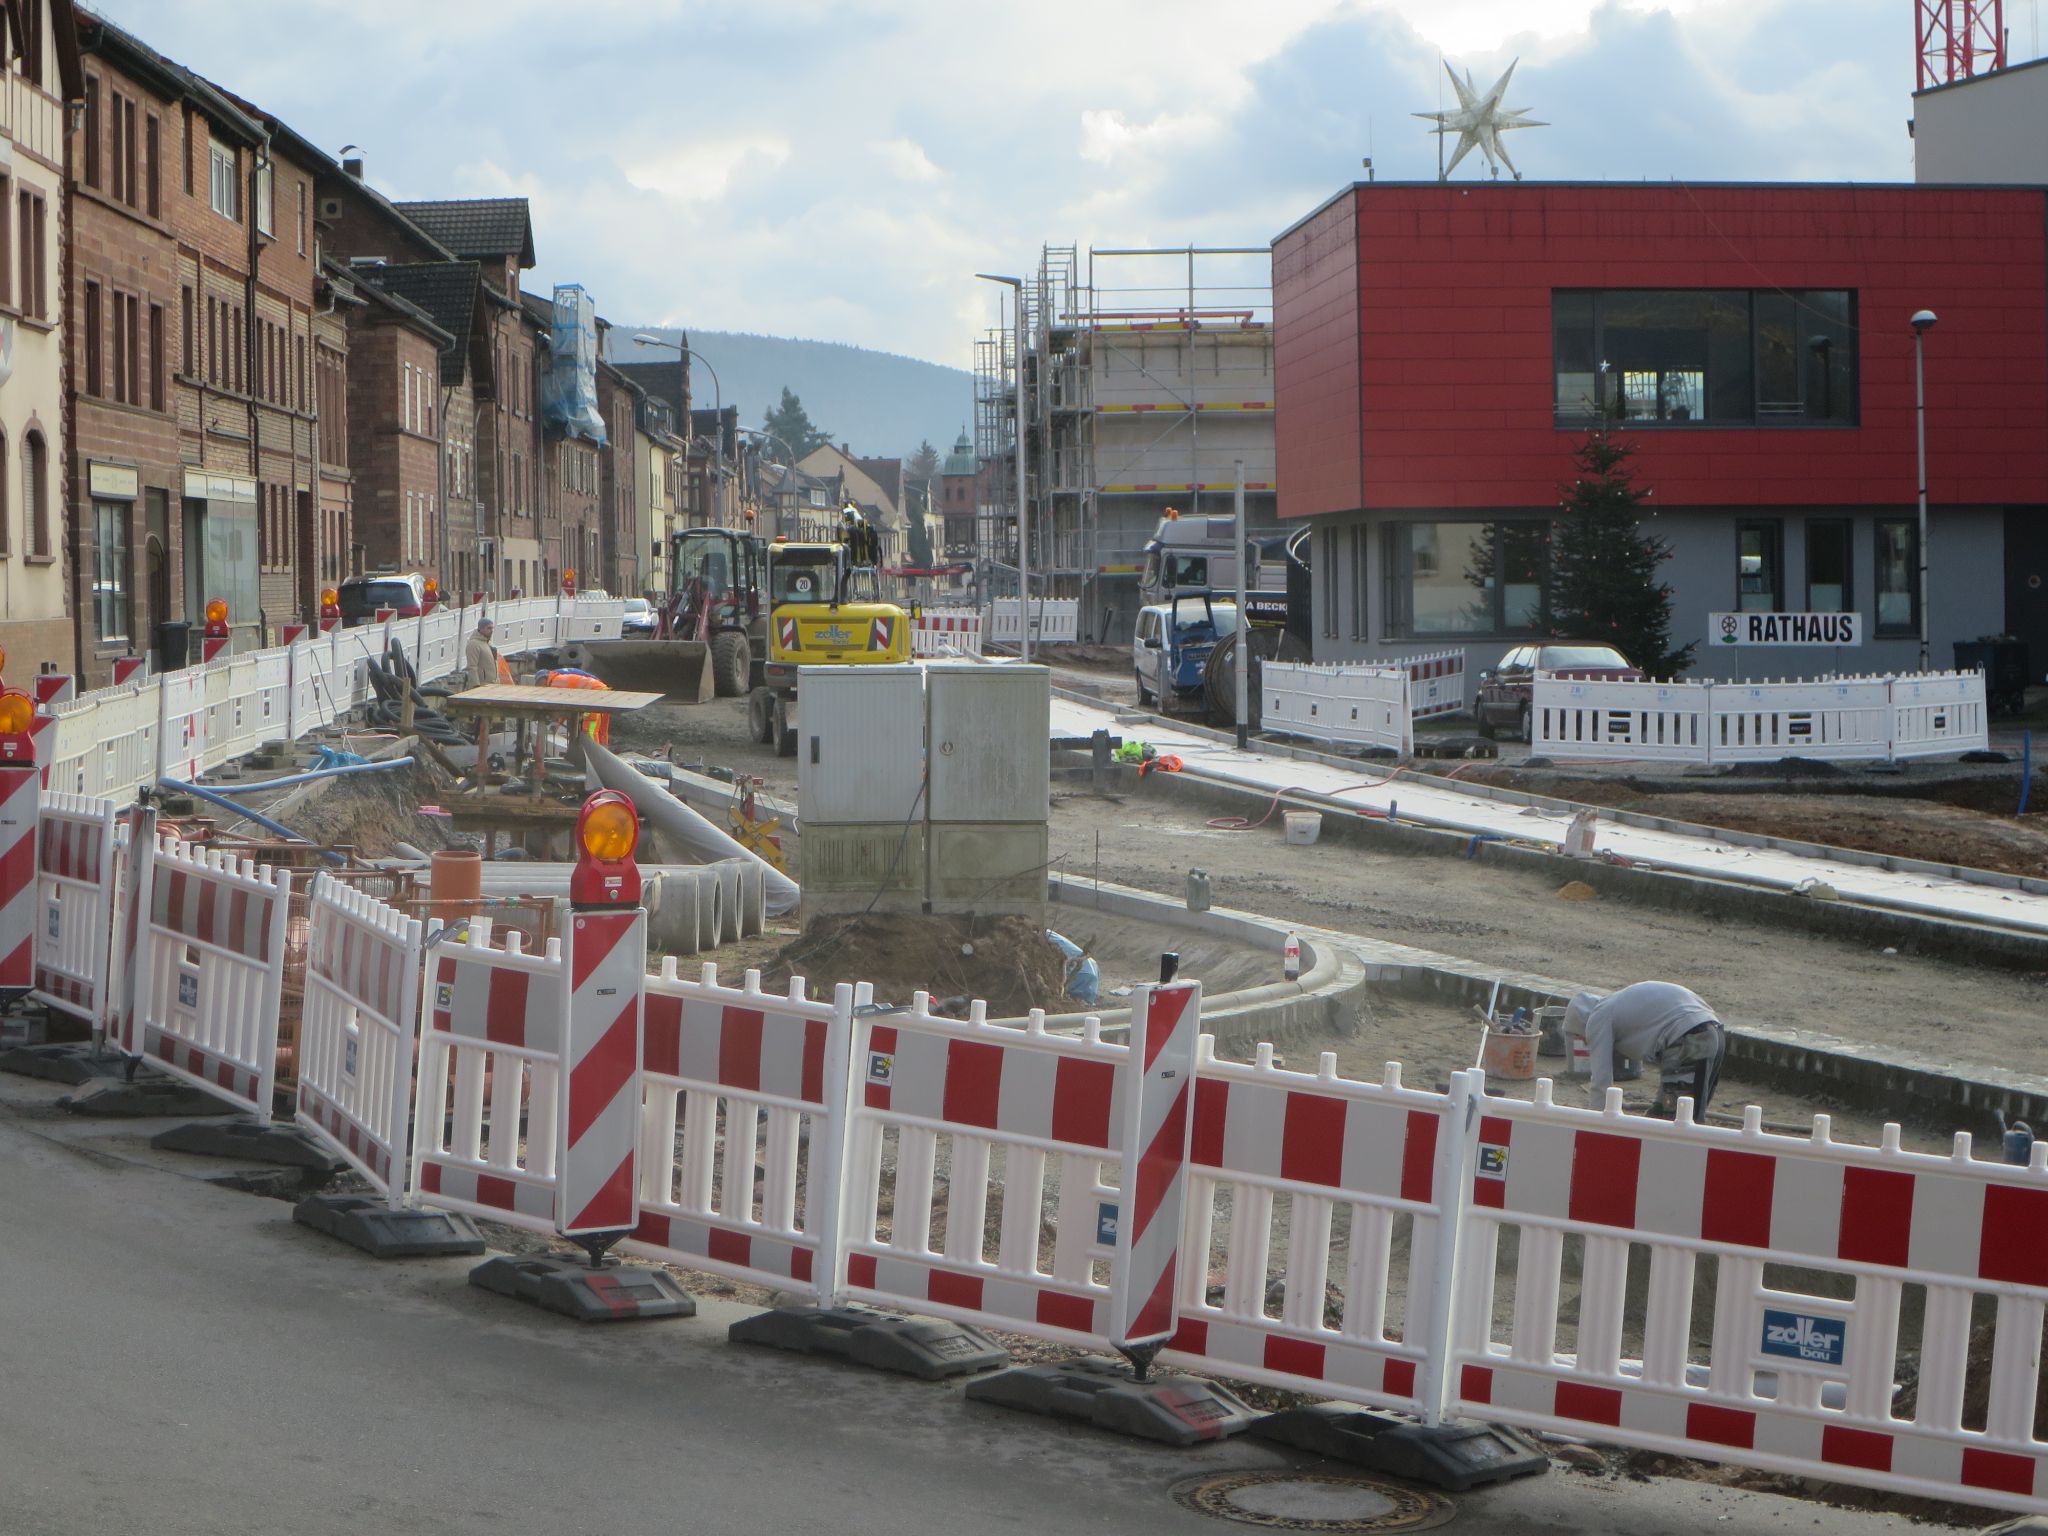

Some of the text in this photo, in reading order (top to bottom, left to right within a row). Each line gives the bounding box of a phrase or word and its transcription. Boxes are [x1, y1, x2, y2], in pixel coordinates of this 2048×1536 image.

[799, 579, 808, 590] 20
[1256, 601, 1287, 612] BECK
[1749, 615, 1853, 642] RATHAUS
[1800, 1345, 1830, 1361] bau
